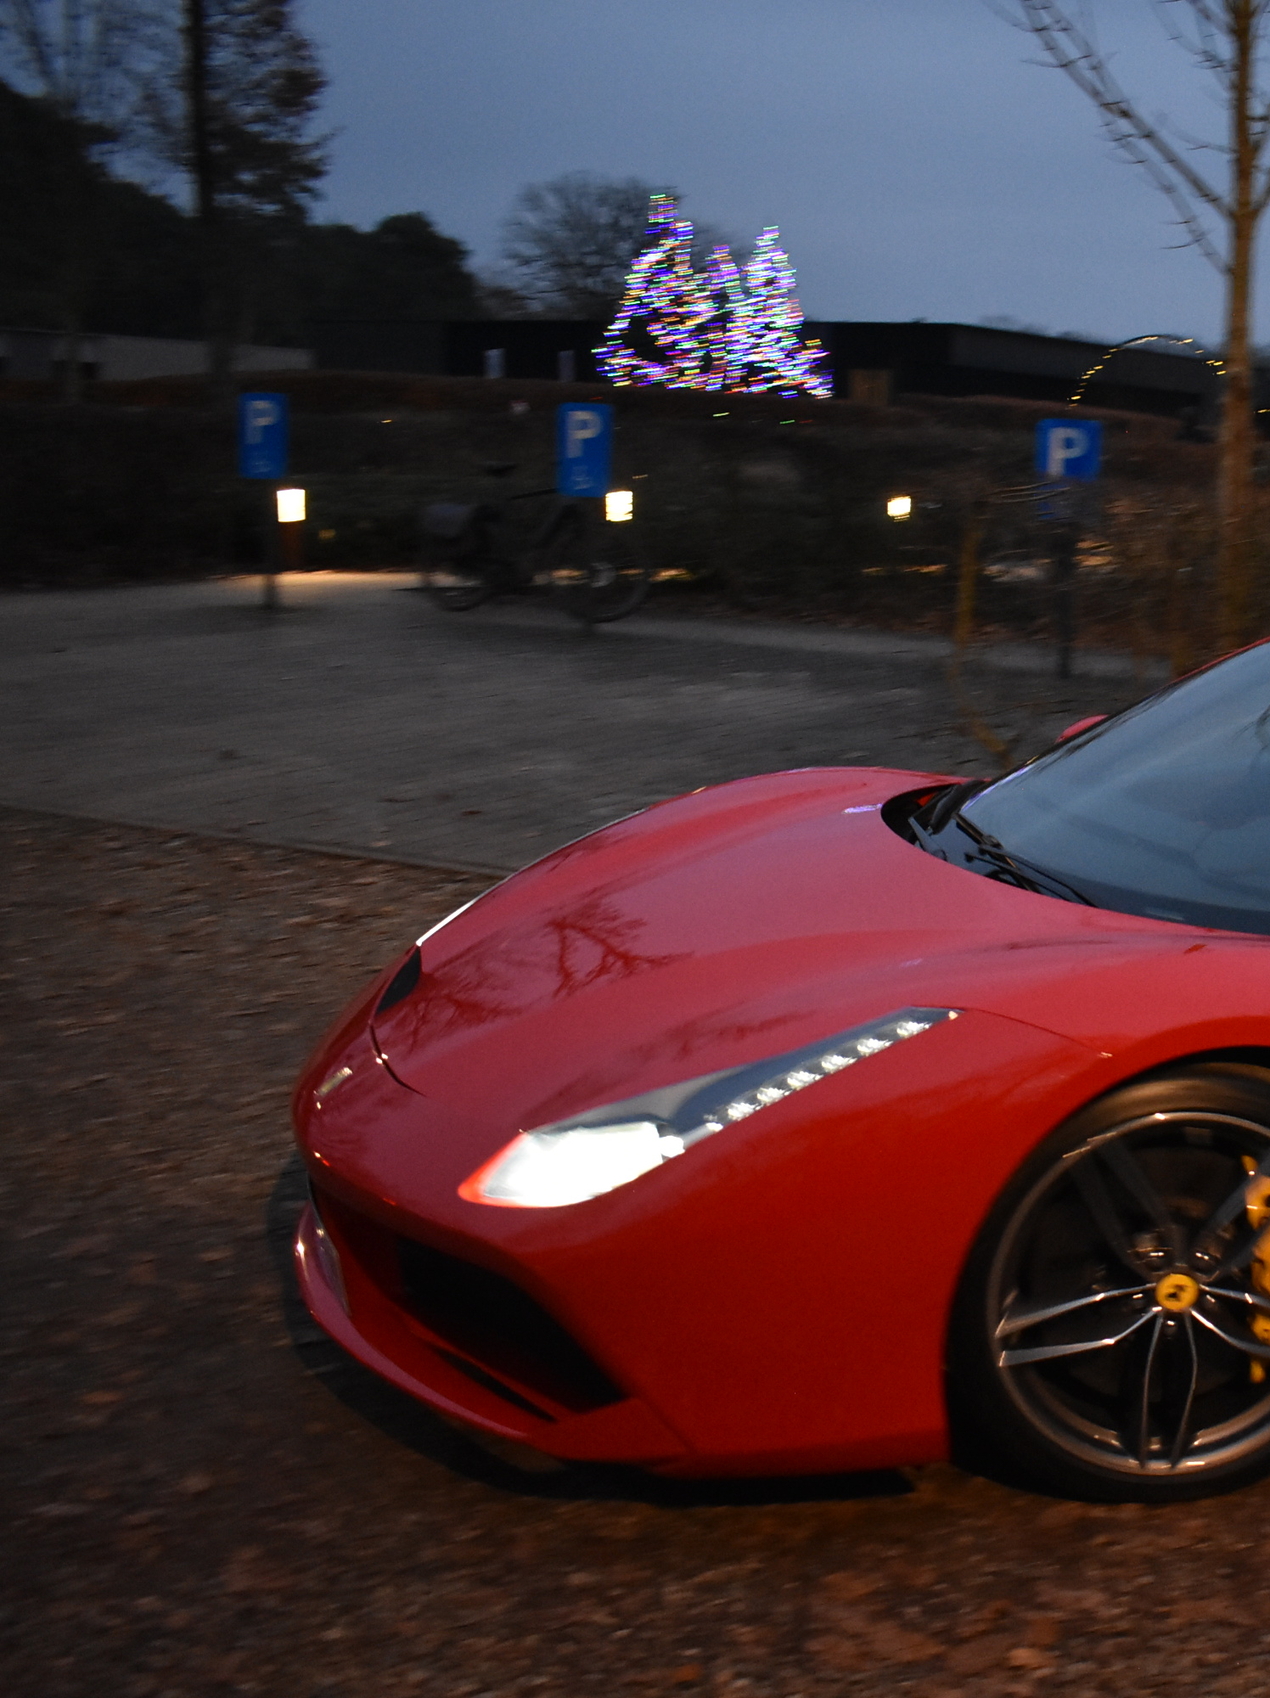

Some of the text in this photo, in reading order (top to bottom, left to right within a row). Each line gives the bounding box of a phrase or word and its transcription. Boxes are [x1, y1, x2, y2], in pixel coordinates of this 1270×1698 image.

[245, 400, 280, 444] P
[566, 410, 603, 458] P
[1046, 427, 1089, 477] P
